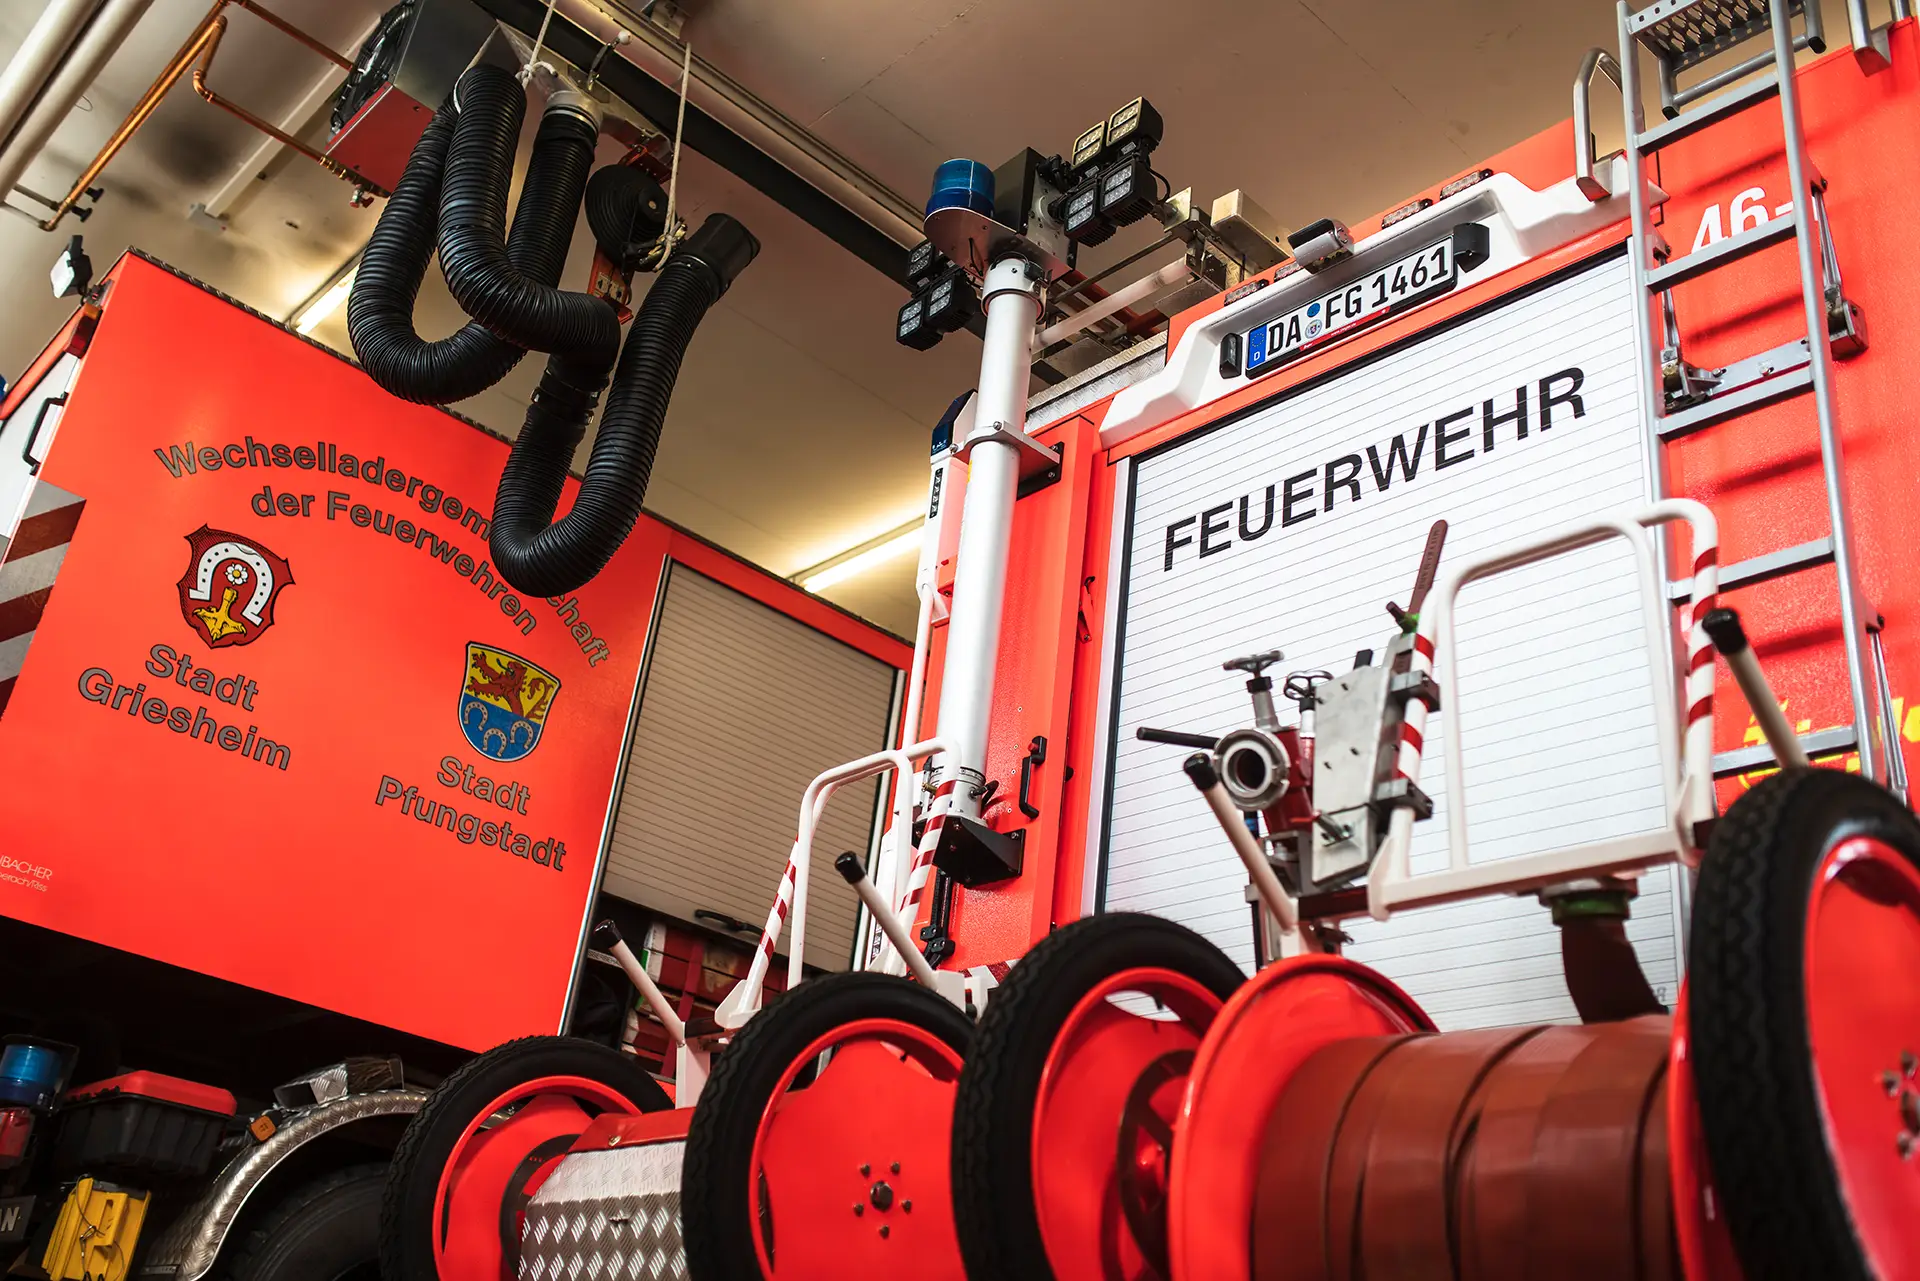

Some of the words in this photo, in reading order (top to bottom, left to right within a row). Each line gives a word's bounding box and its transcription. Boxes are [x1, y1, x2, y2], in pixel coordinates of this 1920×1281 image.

[1253, 350, 1261, 361] D
[1267, 314, 1302, 357] DA
[1325, 285, 1362, 329] FG
[1371, 245, 1449, 308] 1461
[1163, 366, 1586, 573] FEUERWEHR
[251, 486, 315, 518] der
[326, 490, 538, 637] Feuerwehren
[77, 666, 292, 771] Griesheim
[145, 643, 260, 712] Stadt
[375, 774, 567, 872] Pfungstadt
[436, 755, 531, 816] Stadt
[0, 855, 53, 880] BACHER
